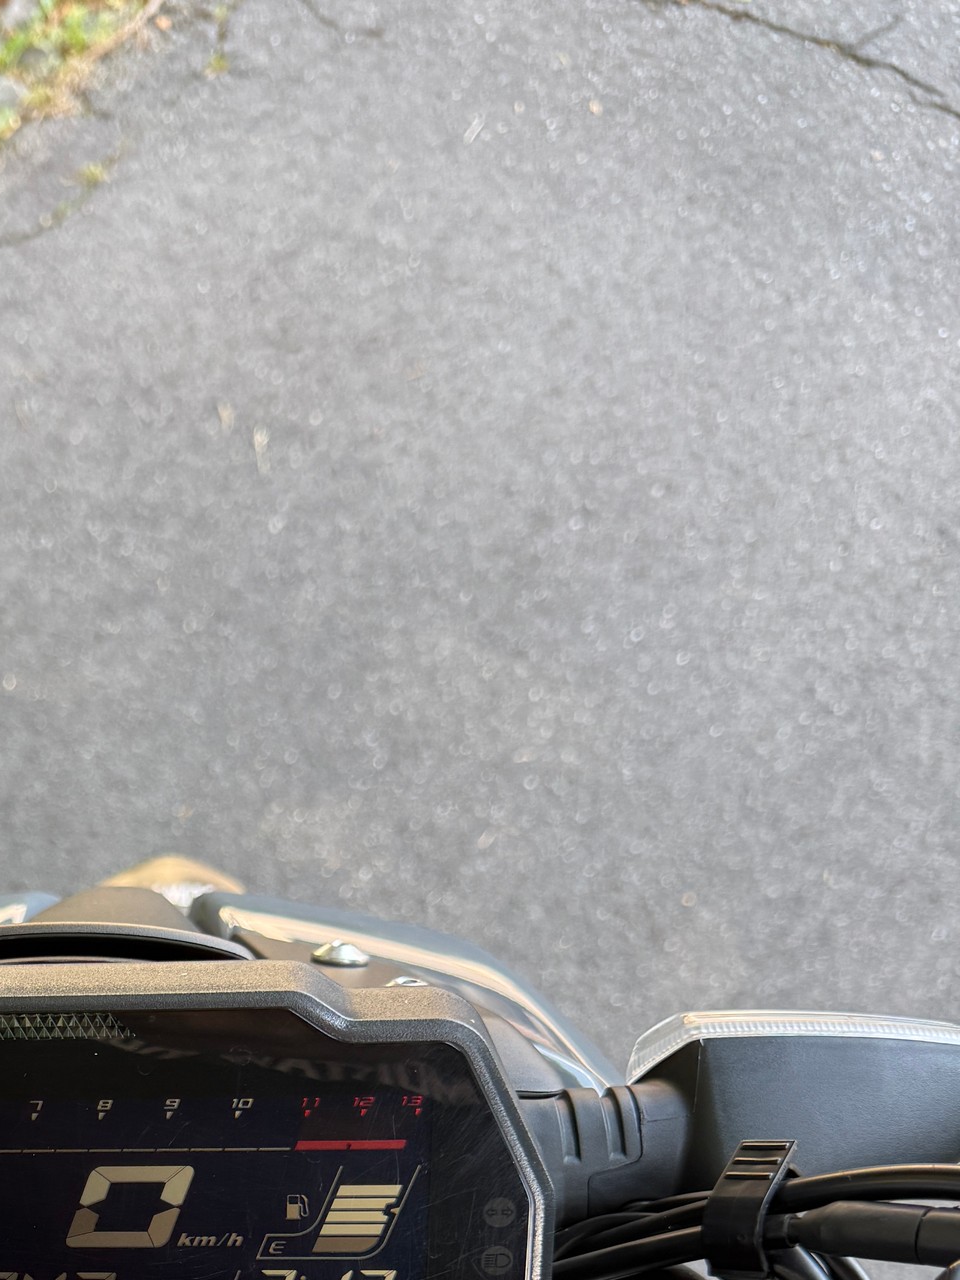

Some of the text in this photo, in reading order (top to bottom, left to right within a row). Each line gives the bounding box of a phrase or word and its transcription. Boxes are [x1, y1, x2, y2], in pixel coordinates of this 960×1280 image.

[29, 1100, 44, 1111] 7
[96, 1099, 114, 1110] 8
[163, 1098, 181, 1109] 9
[231, 1098, 254, 1109] 10
[301, 1097, 321, 1108] 11
[353, 1096, 376, 1107] 12
[402, 1095, 423, 1106] 13
[65, 1165, 244, 1248] 0 km/h
[268, 1240, 287, 1254] E
